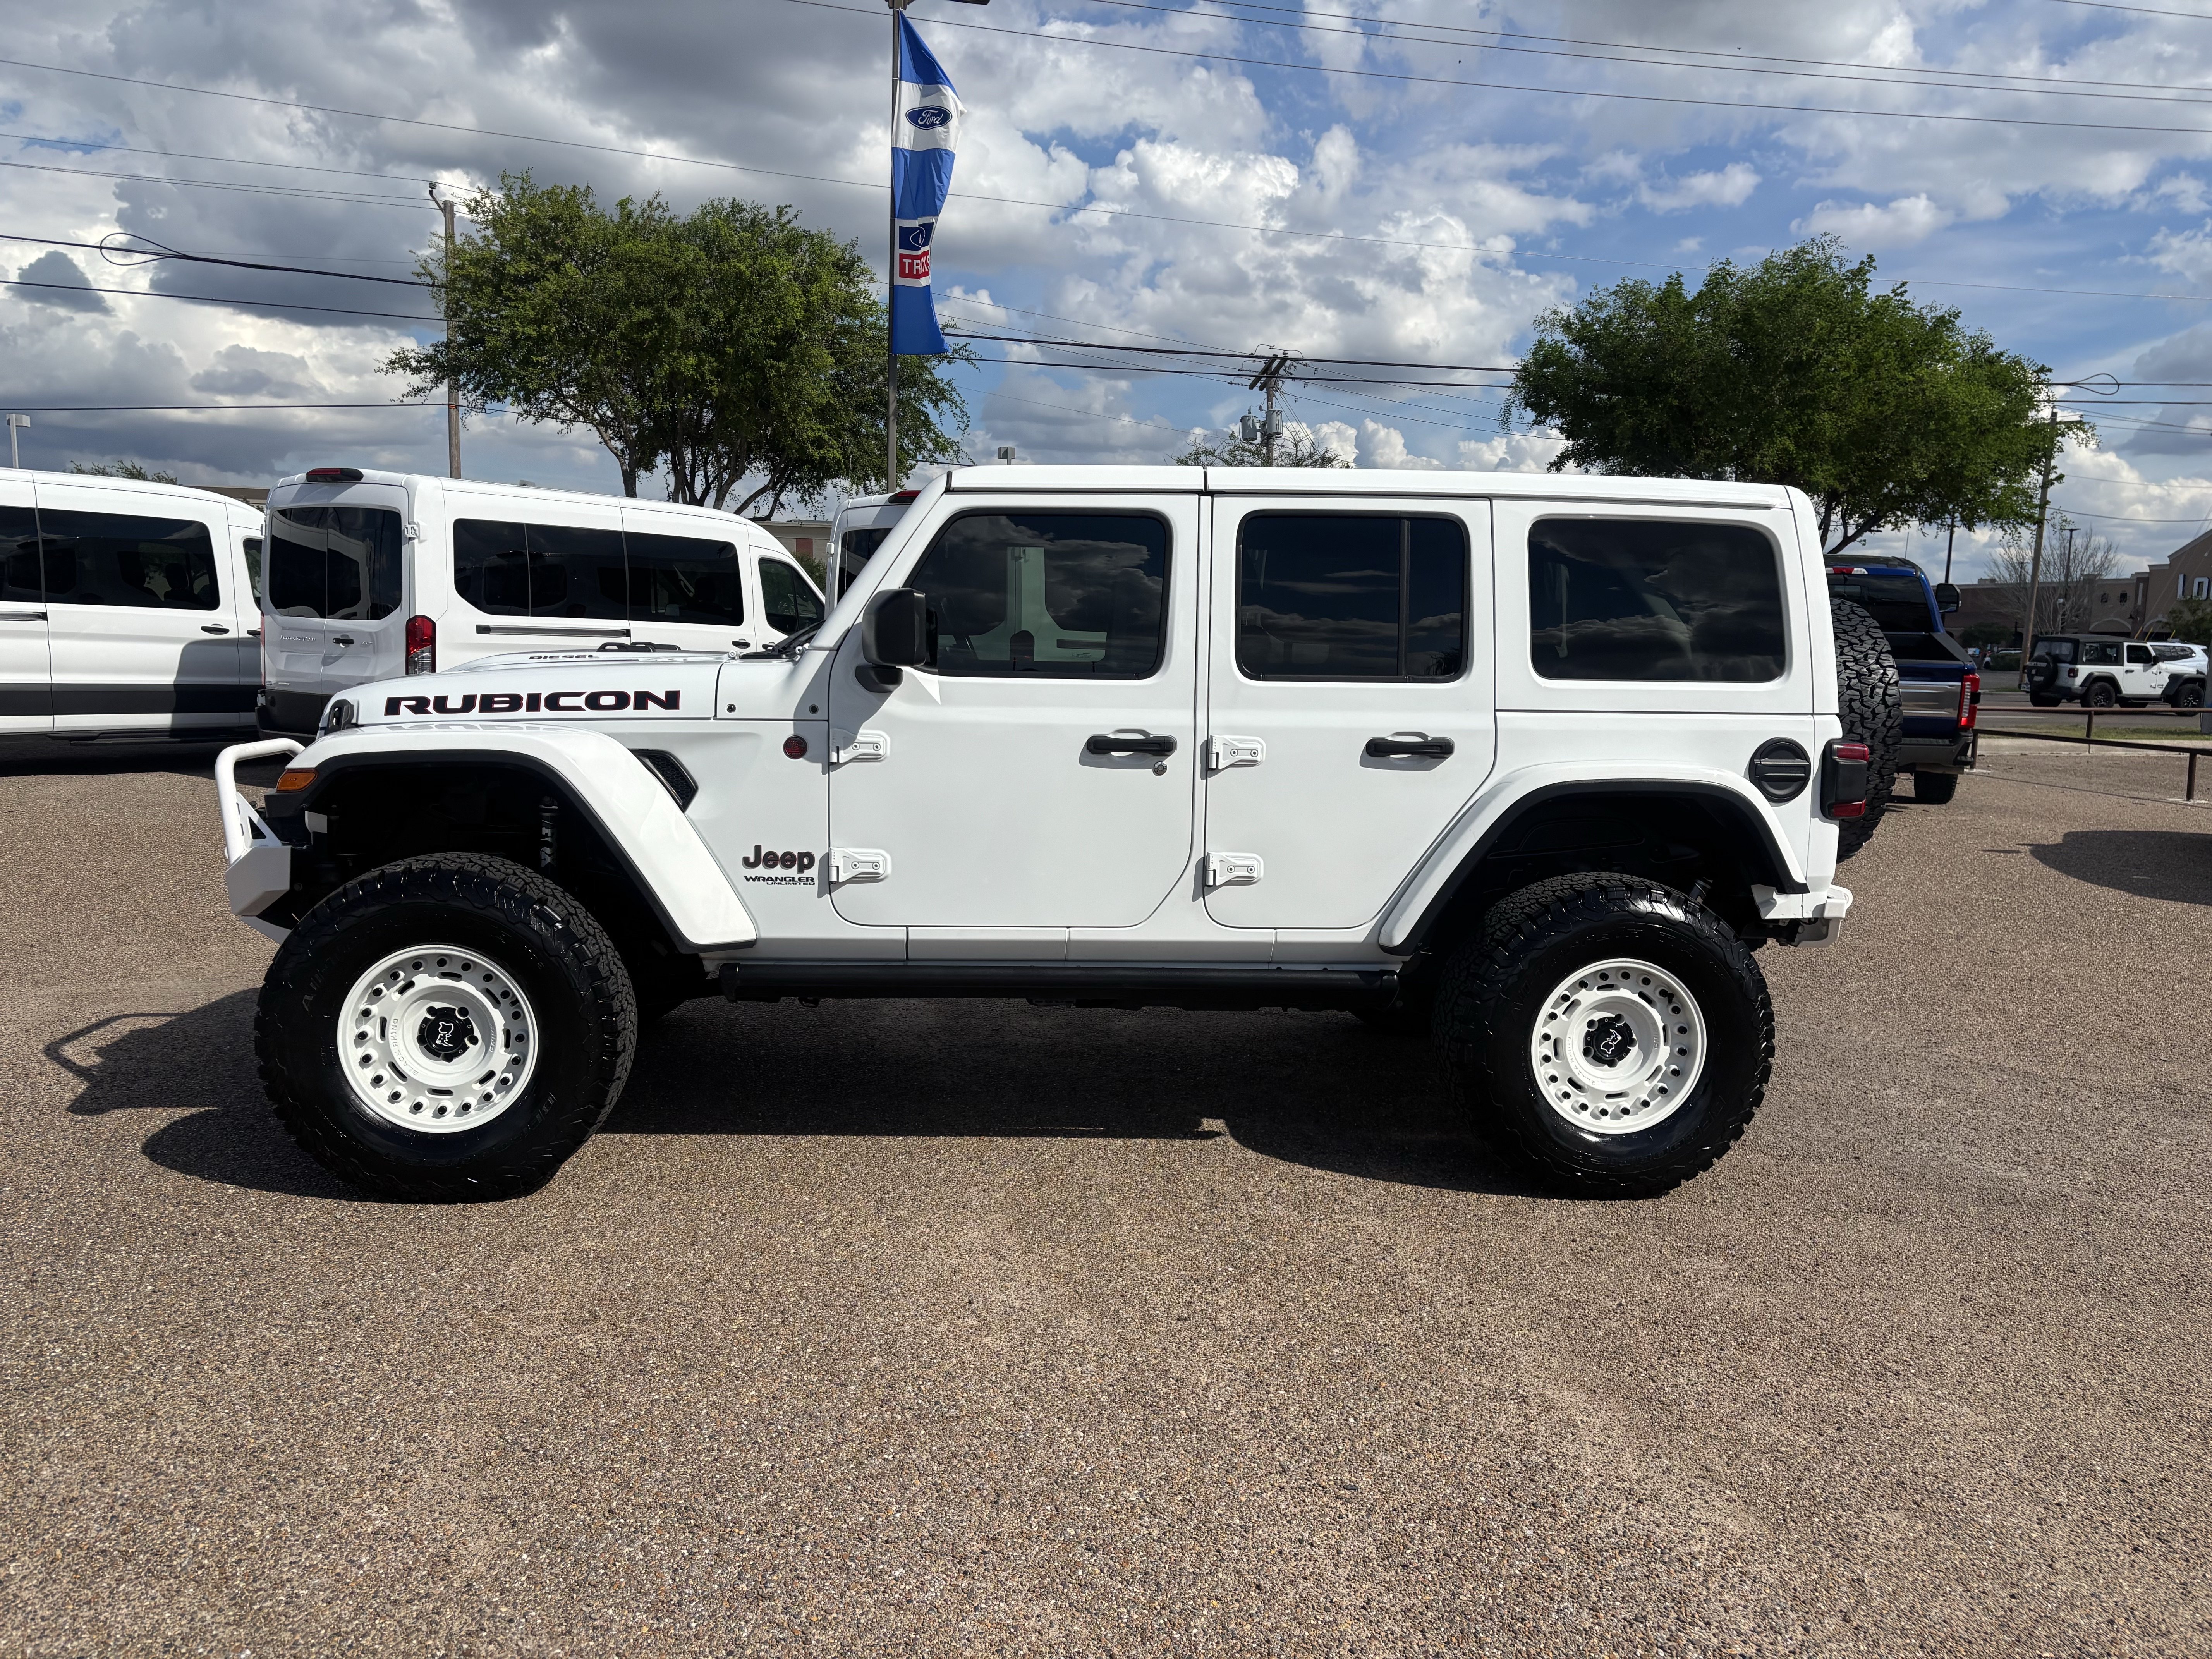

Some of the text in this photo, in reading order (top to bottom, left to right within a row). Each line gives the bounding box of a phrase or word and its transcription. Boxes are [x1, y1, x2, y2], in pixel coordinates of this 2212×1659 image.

[918, 109, 943, 125] Ford
[2177, 574, 2212, 600] LO
[384, 690, 680, 716] RUBICON
[742, 845, 815, 874] Jeep
